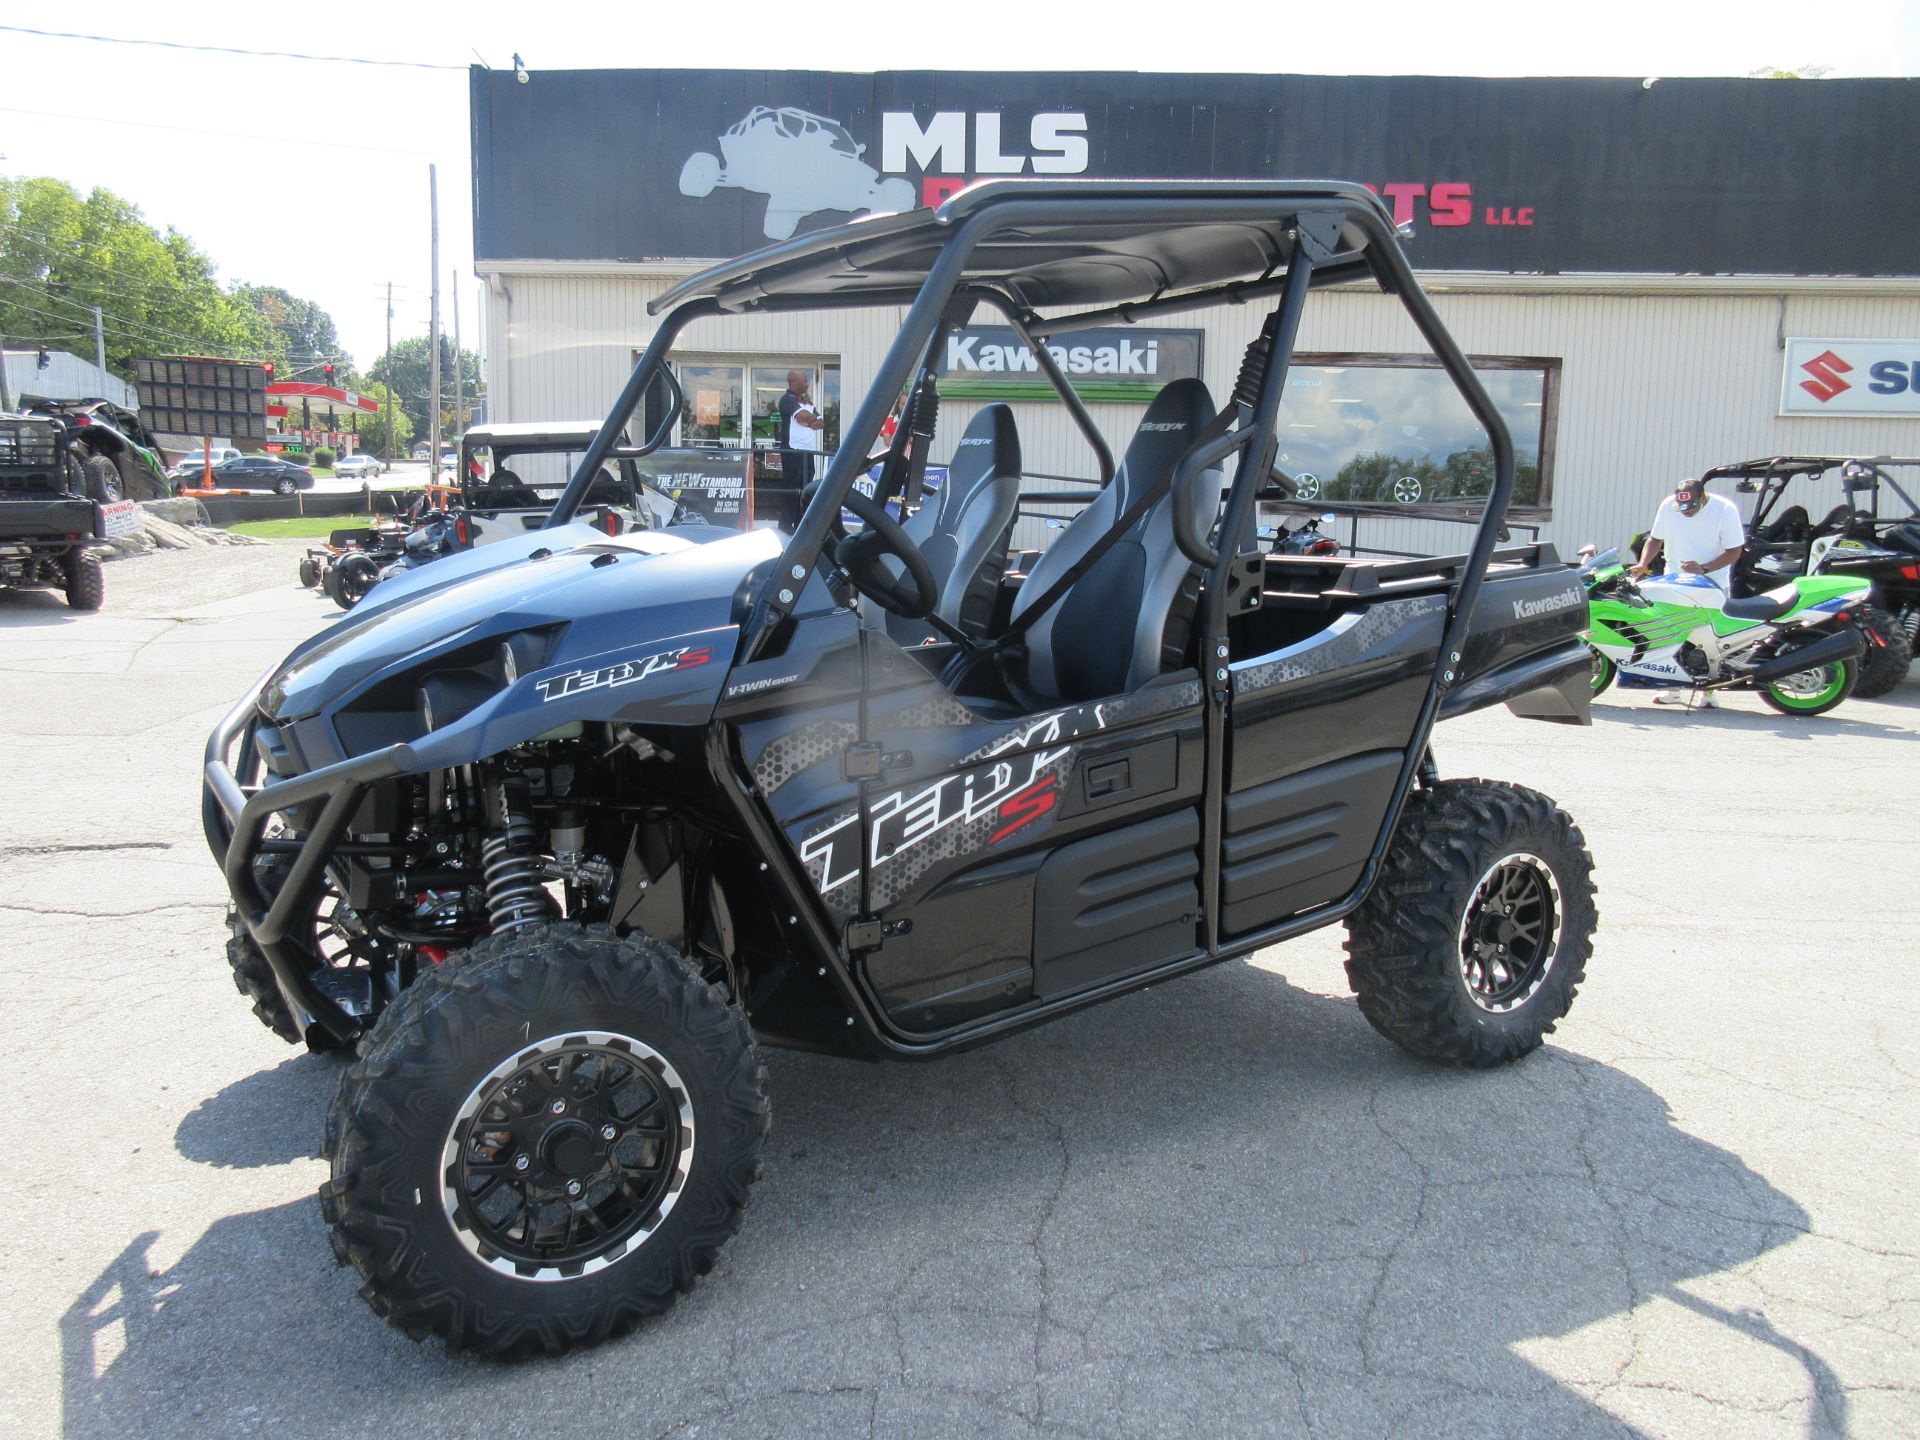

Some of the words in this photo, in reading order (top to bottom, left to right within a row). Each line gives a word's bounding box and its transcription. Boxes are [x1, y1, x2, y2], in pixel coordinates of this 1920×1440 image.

[882, 111, 1089, 174] MLS
[1485, 207, 1535, 226] LLC
[946, 336, 1158, 375] Kawasaki
[1868, 360, 1920, 395] S
[657, 474, 673, 487] THE
[672, 472, 703, 488] NEW
[699, 477, 743, 488] STANDARD
[707, 488, 719, 499] OF
[719, 488, 746, 499] SPORT
[1512, 586, 1581, 619] Kawasaki
